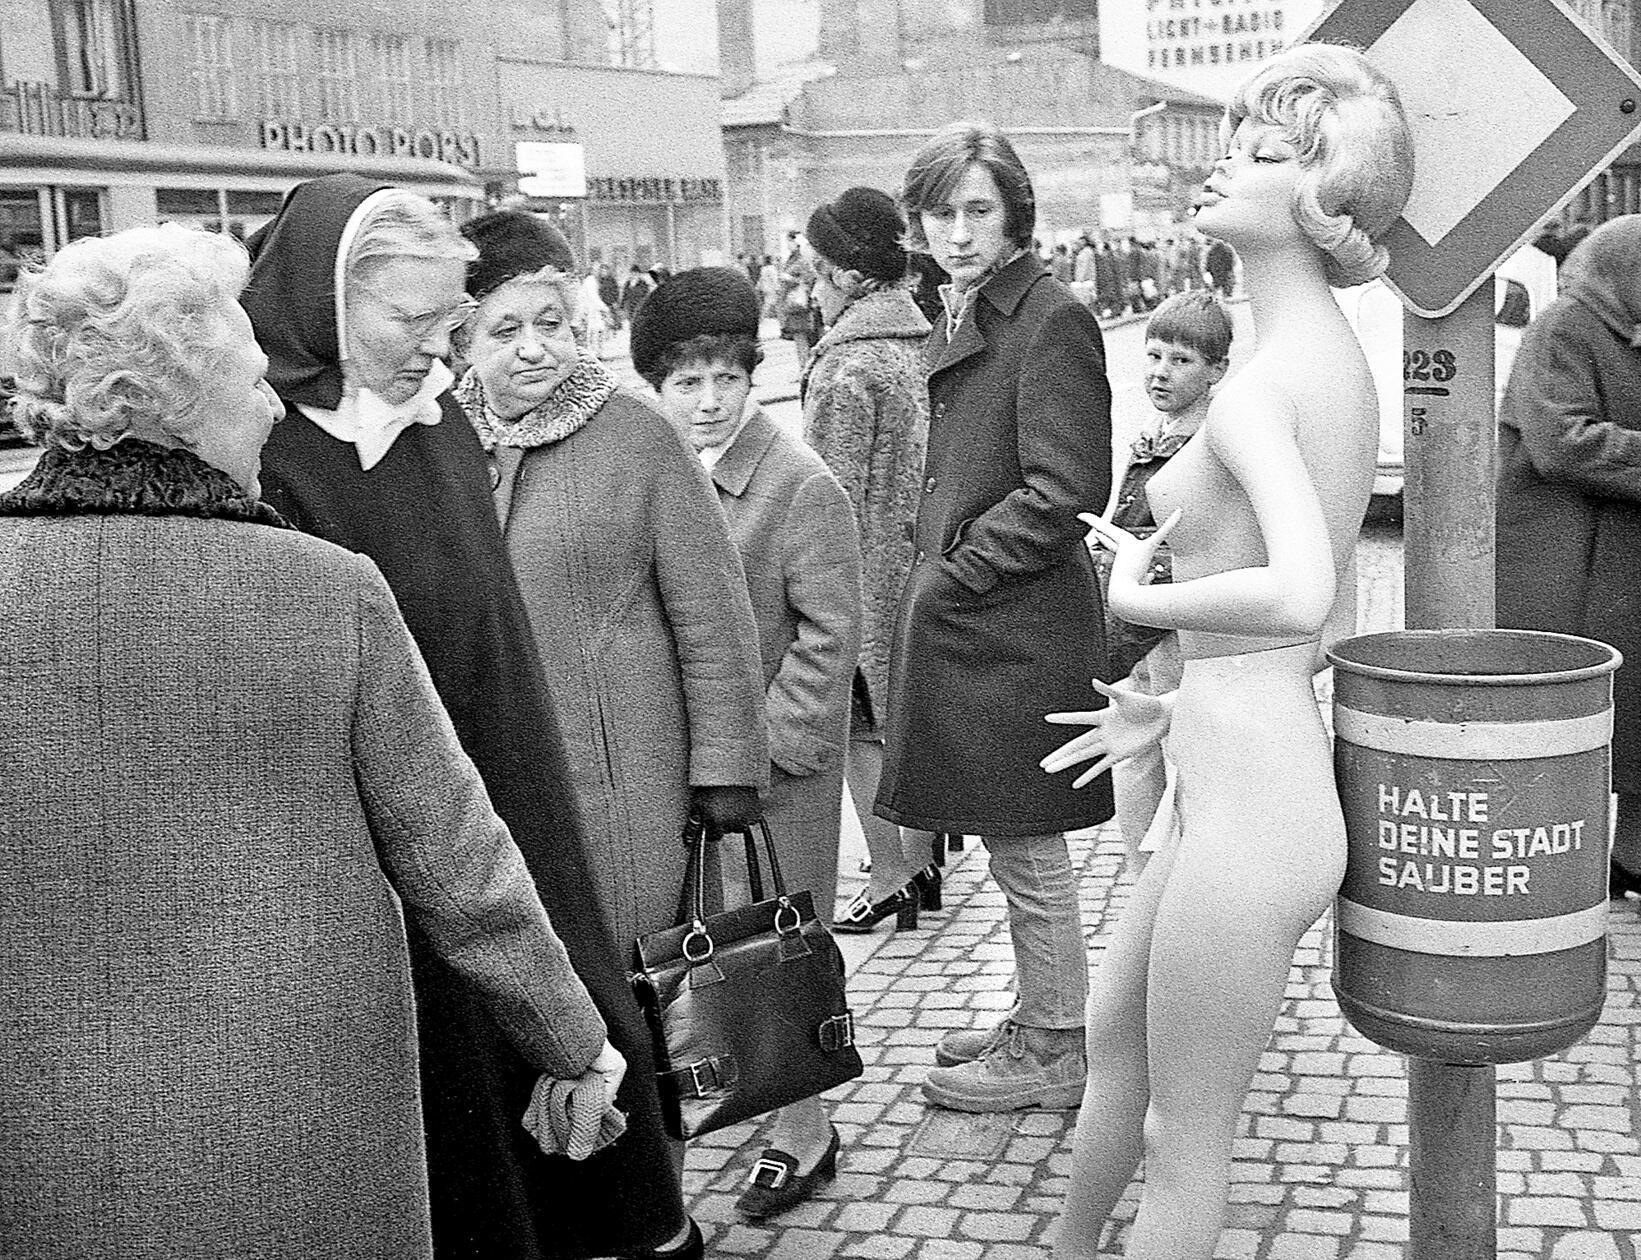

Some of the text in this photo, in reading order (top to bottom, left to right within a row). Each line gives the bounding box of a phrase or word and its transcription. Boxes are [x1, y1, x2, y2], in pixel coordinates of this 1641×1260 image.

[259, 121, 376, 154] PHOTO
[1378, 783, 1488, 822] HALTE
[1378, 819, 1585, 859] DEINE STADT
[1378, 856, 1531, 895] SAUBER
